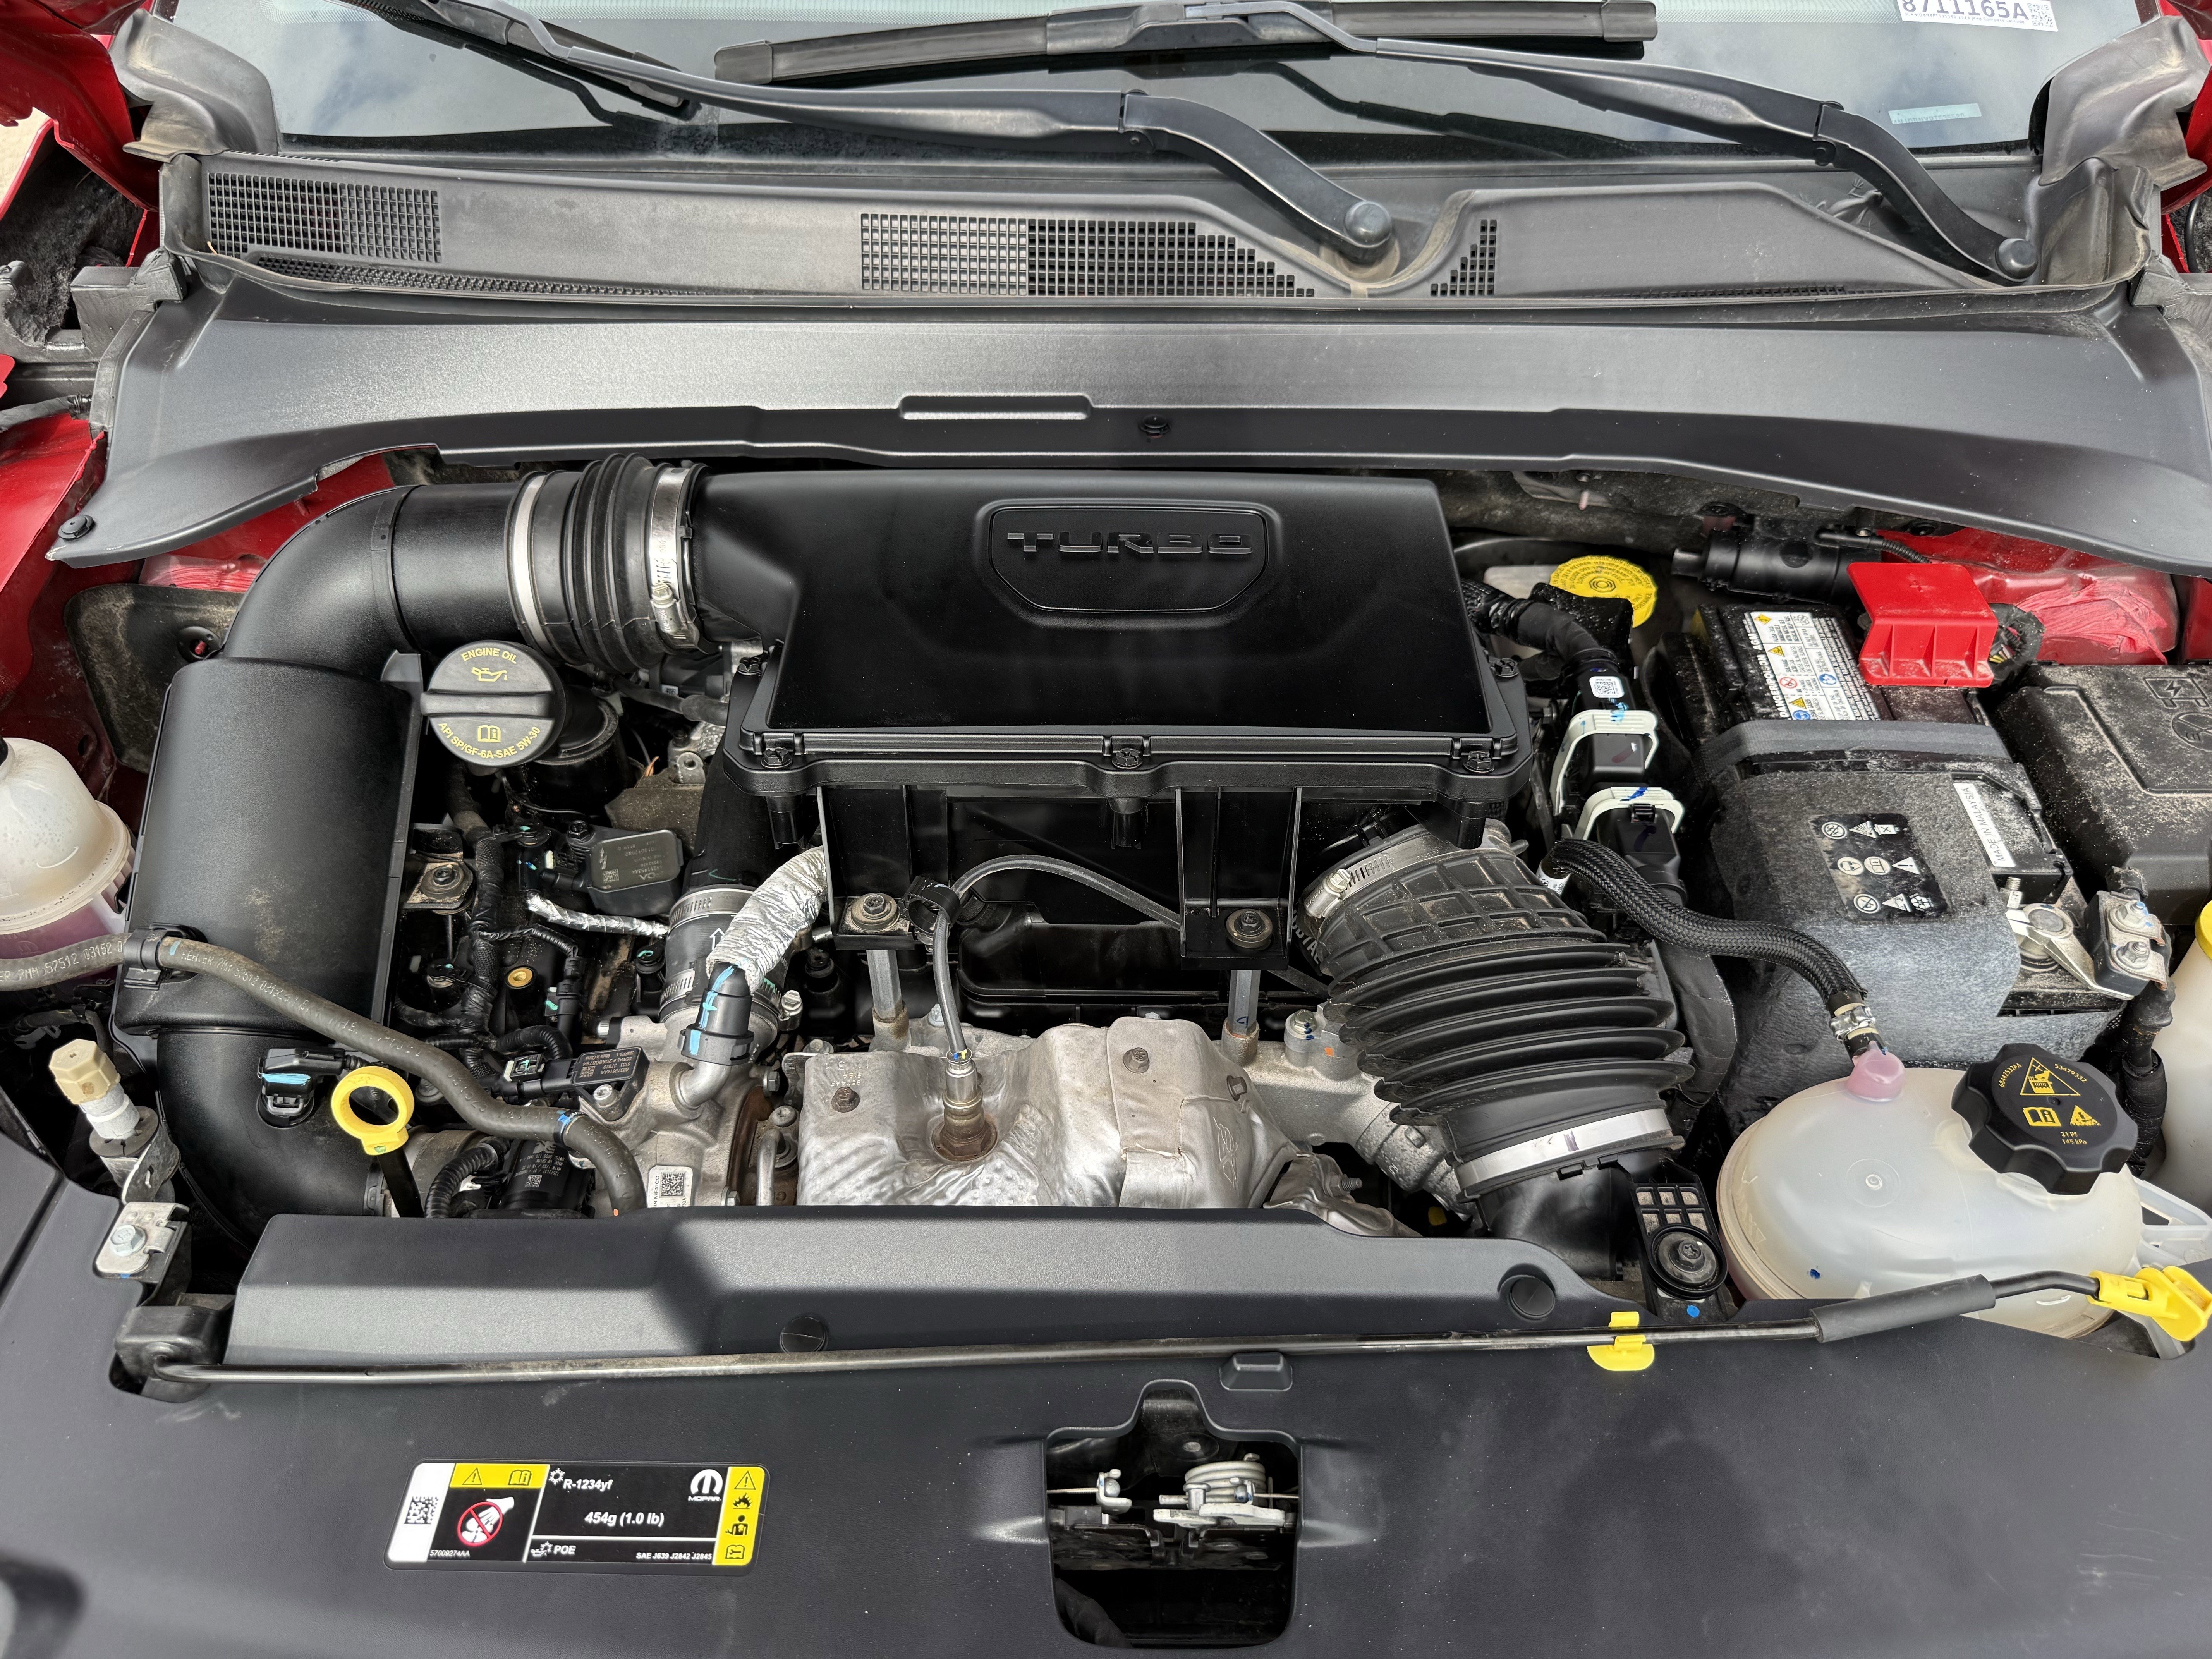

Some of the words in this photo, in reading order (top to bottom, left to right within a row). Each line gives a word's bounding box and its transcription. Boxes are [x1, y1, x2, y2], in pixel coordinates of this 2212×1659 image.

[1007, 531, 1253, 554] TURBO
[461, 647, 500, 662] ENGINE
[501, 651, 517, 664] OIL
[438, 723, 453, 738] API
[517, 726, 540, 749] 5W-30
[1961, 787, 1986, 826] MALAYSIA
[1983, 828, 1992, 836] IN
[1987, 838, 2006, 861] MADE
[44, 953, 80, 974] 57512
[2054, 1063, 2087, 1083] 53479332
[563, 1479, 613, 1491] R-1234yf
[584, 1511, 617, 1527] 454g
[620, 1512, 644, 1527] (1.0
[646, 1512, 665, 1527] lb)
[554, 1546, 576, 1555] POE
